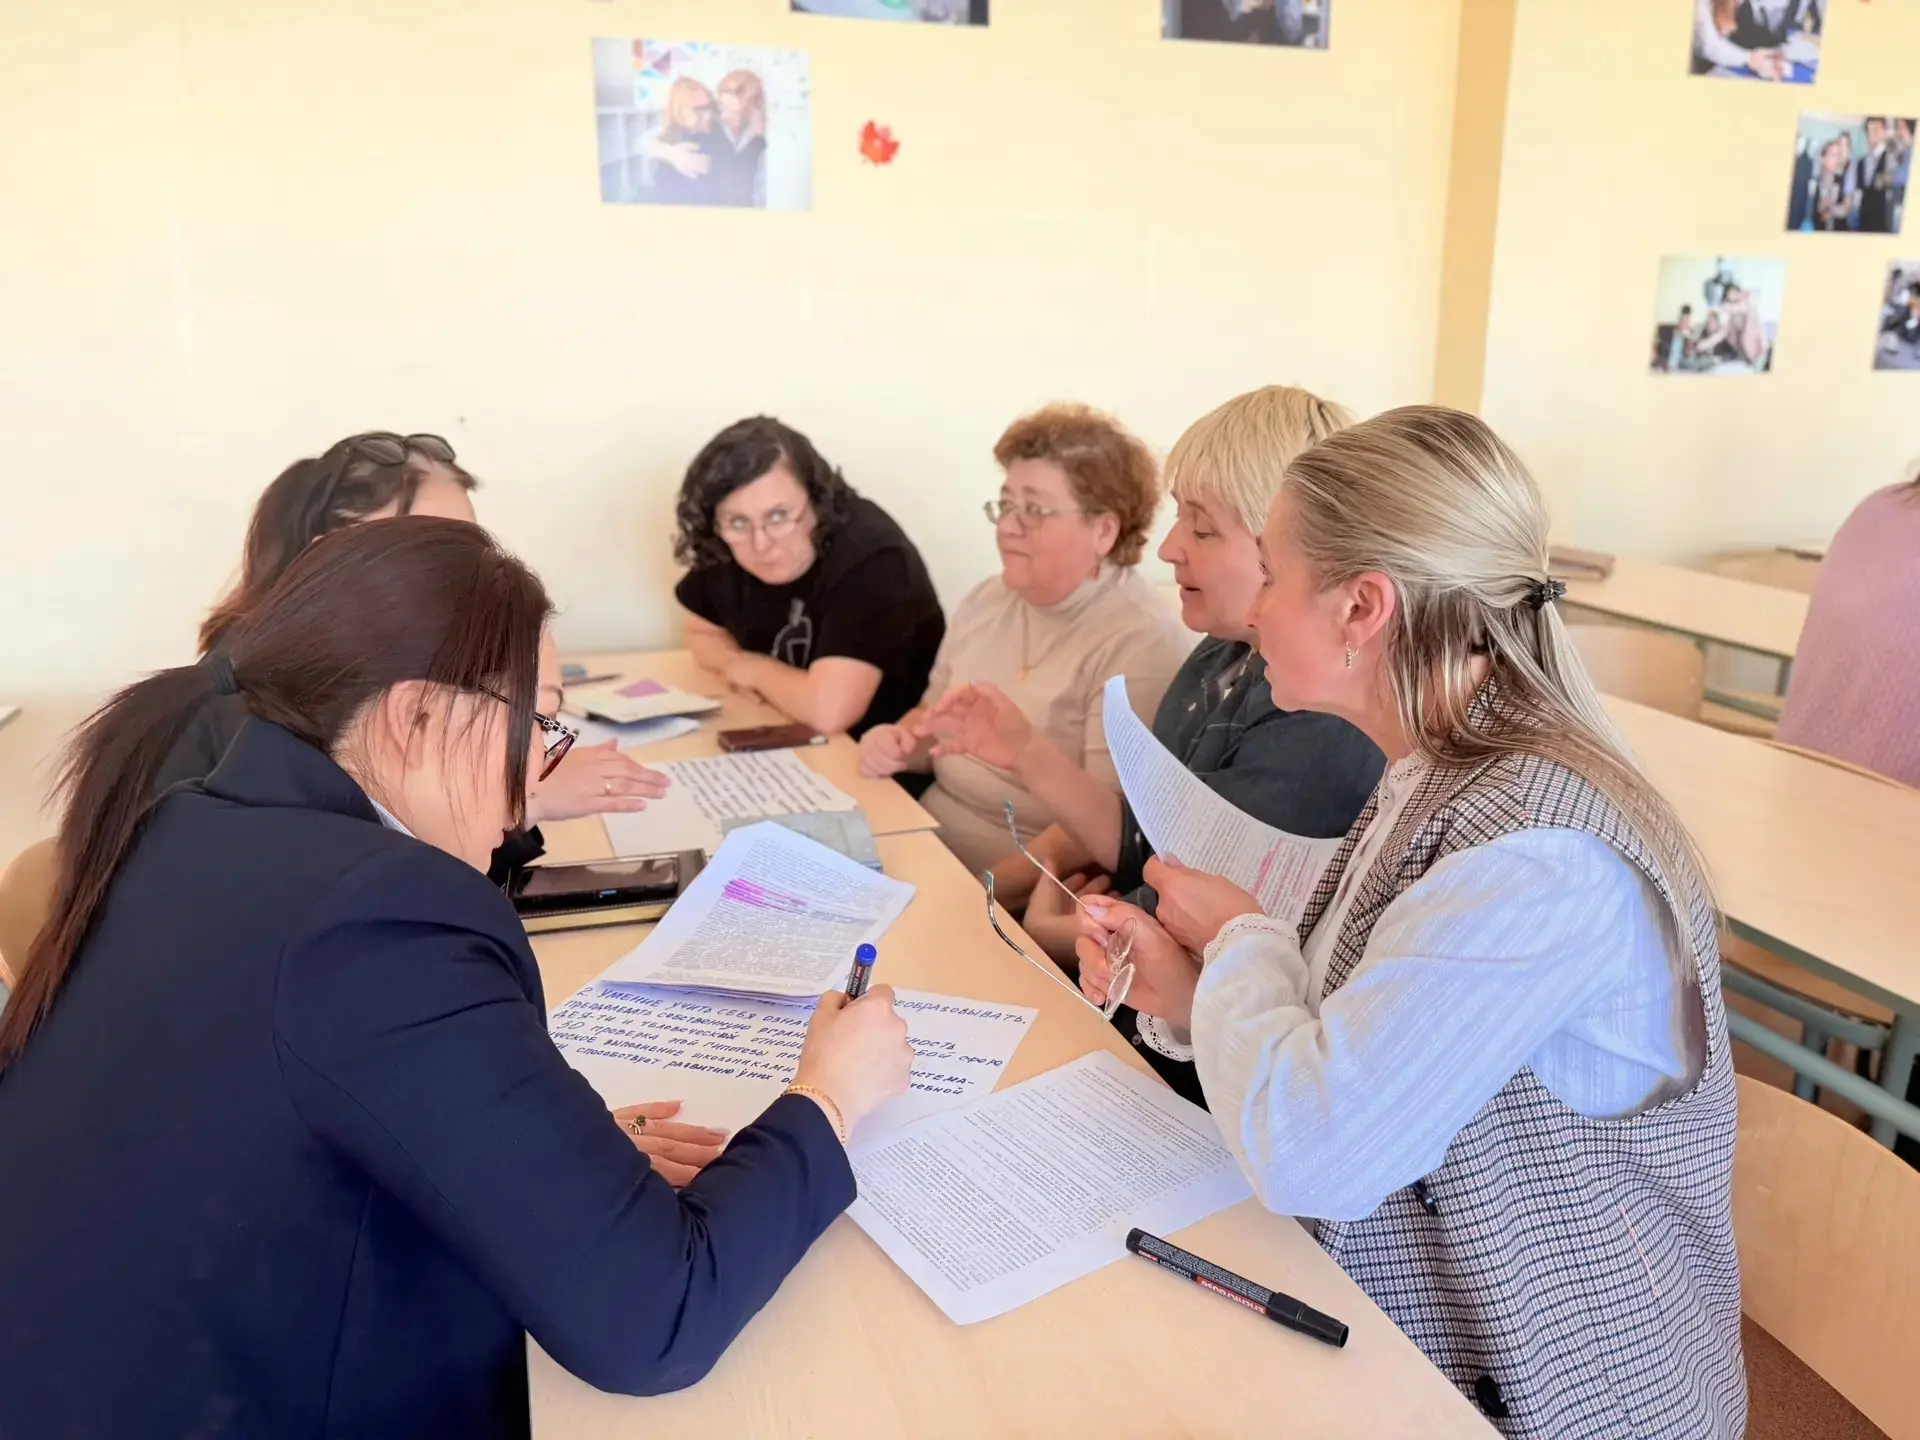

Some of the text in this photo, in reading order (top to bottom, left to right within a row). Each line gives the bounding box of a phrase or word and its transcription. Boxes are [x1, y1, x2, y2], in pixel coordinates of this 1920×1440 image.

[597, 988, 664, 1007] УМЕНИЕ
[665, 1001, 712, 1013] УЧИТЬ
[717, 1008, 757, 1020] СЕБЯ
